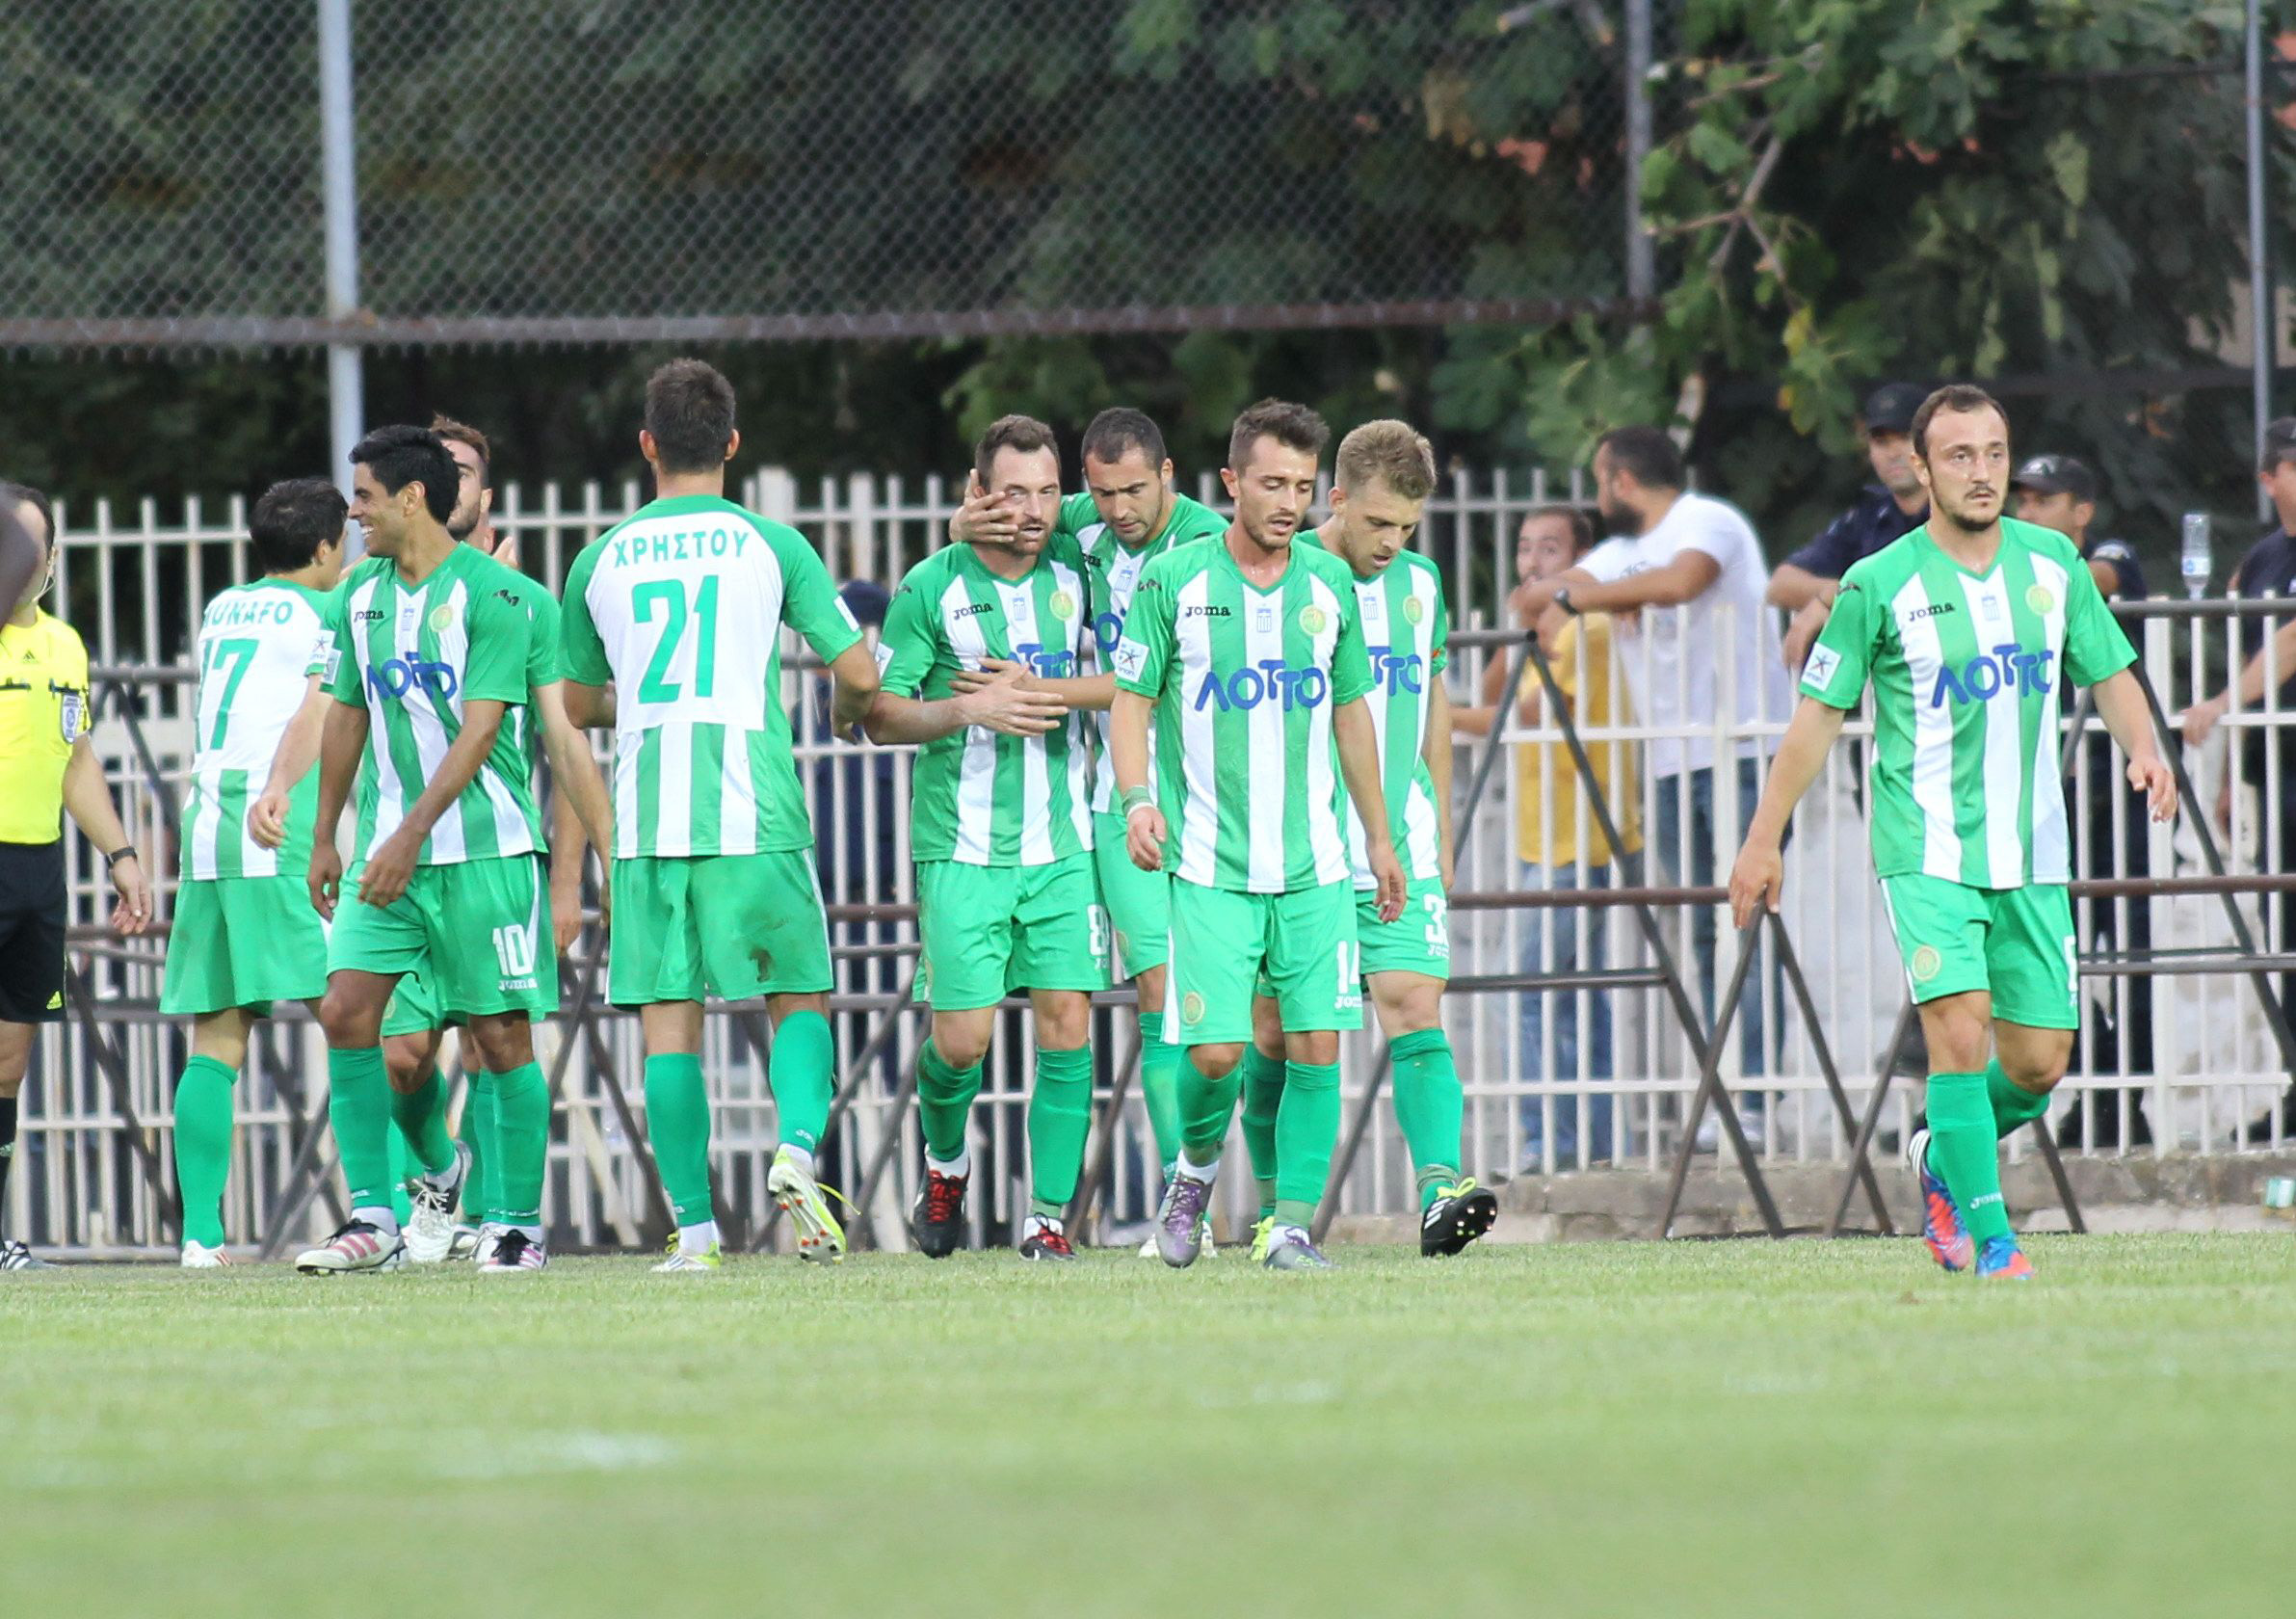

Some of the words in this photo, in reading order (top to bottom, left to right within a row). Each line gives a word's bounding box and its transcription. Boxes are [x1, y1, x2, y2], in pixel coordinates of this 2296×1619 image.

[614, 528, 750, 568] ΧΡΗΣΤΟΥ
[631, 574, 719, 704] 21
[492, 924, 534, 977] 10
